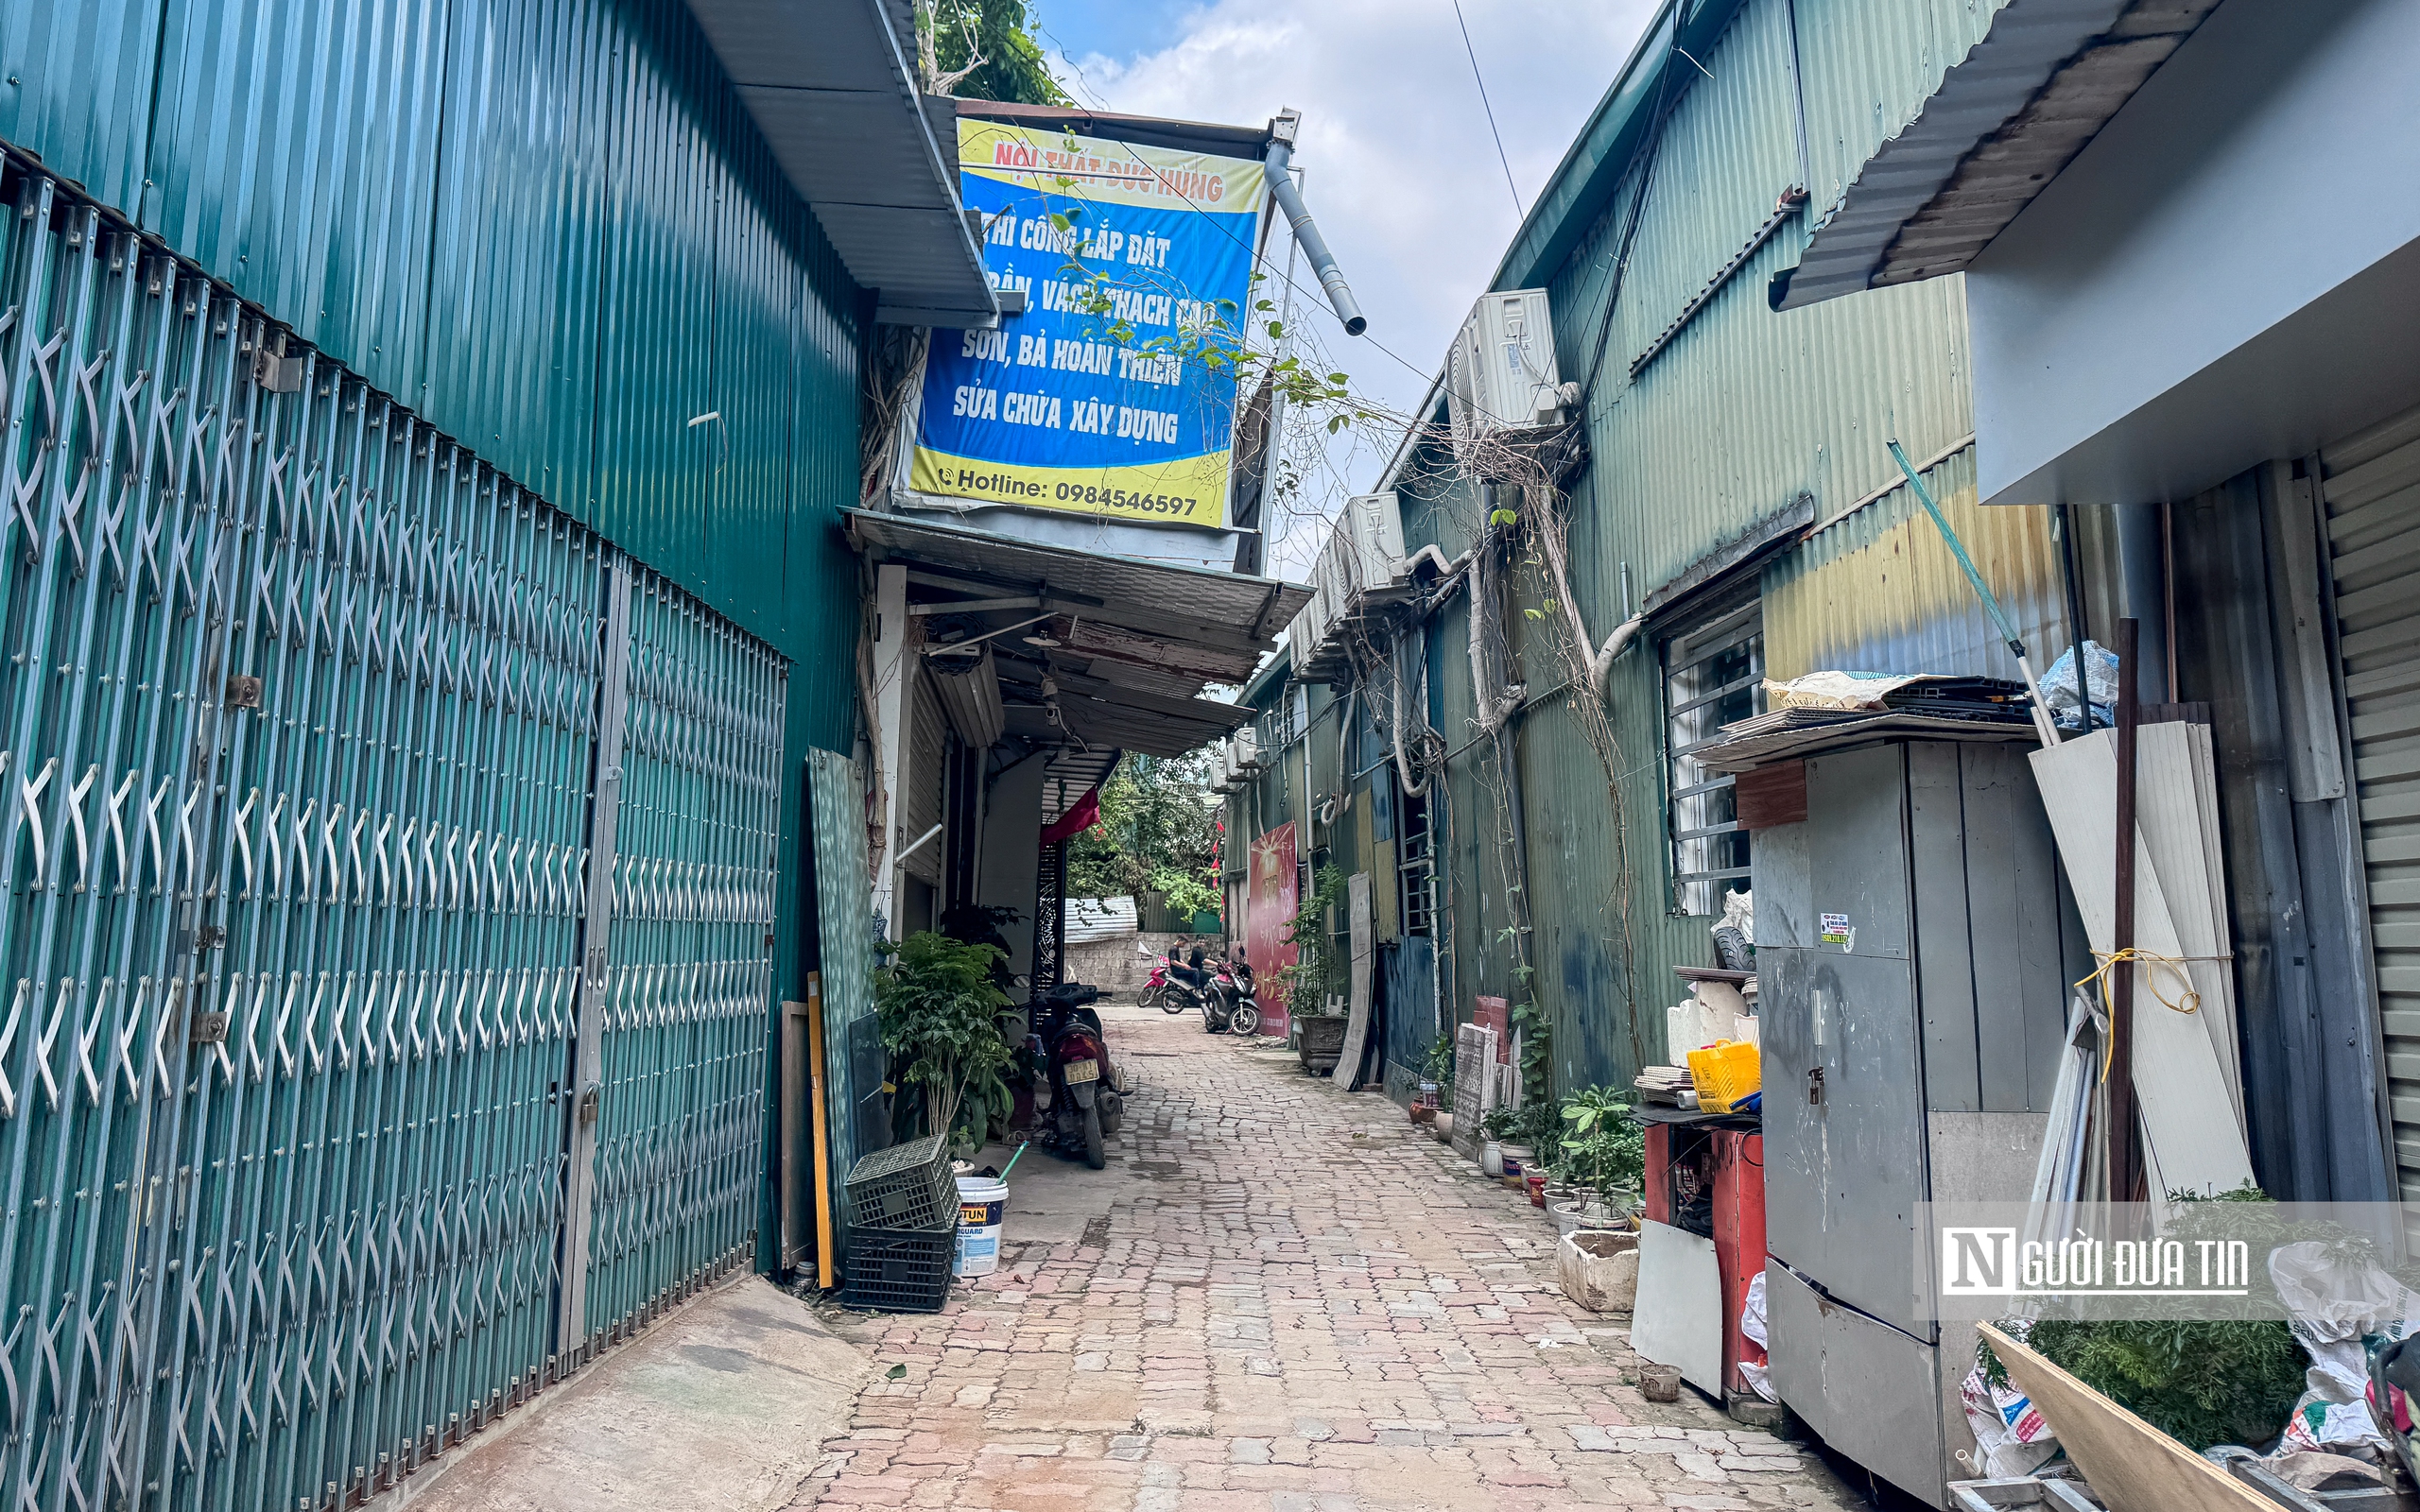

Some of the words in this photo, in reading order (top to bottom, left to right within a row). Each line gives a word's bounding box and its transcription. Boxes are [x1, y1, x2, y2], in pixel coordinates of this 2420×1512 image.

[1020, 215, 1077, 256] CÔNG
[1080, 218, 1123, 262] LẮP
[1127, 230, 1171, 270] ĐẶT
[1102, 286, 1171, 328] THẠCH
[961, 329, 1011, 369] SƠN,
[1017, 328, 1046, 368] BẢ
[1051, 336, 1114, 376] HOÀN
[1117, 347, 1183, 389] THIỆN
[953, 378, 997, 421] SỬA
[1003, 389, 1061, 429] CHỮA
[1069, 395, 1115, 436] XÂY
[1116, 406, 1179, 446] DỰNG
[958, 469, 1047, 498] Hotline:
[1055, 482, 1197, 517] 0984546597
[959, 1210, 985, 1220] TUN
